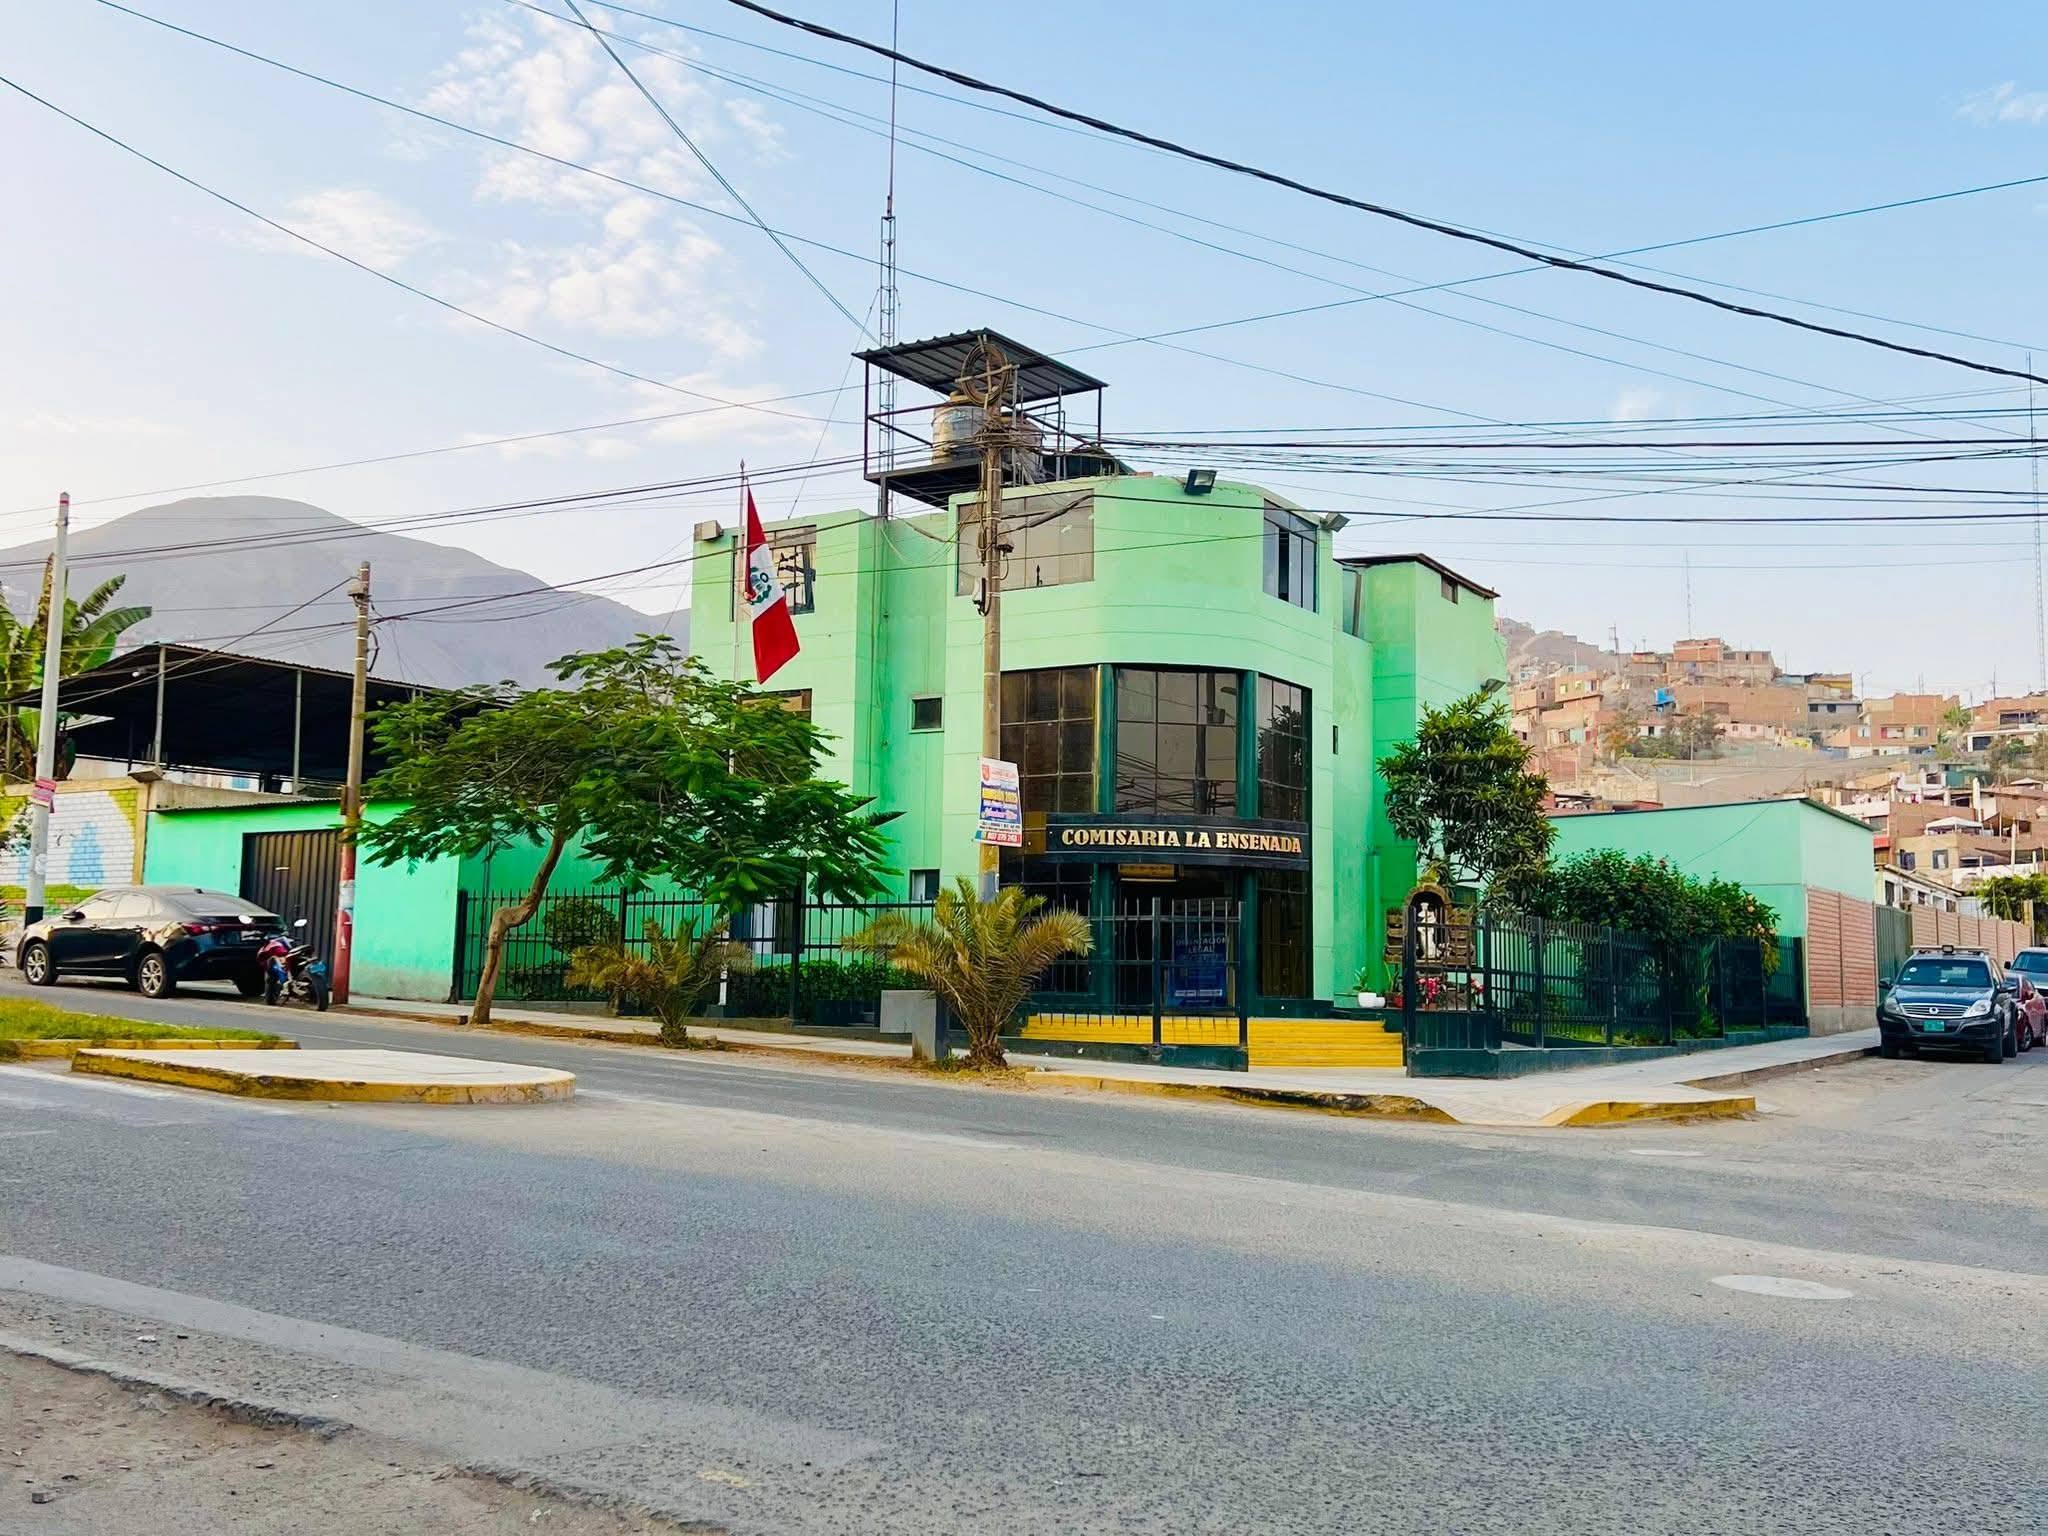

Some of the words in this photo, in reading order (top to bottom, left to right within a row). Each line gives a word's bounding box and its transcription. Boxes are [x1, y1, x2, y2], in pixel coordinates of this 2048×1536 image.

[1062, 829, 1181, 847] COMISARIA
[1185, 831, 1211, 848] LA
[1215, 832, 1302, 853] ENSENADA
